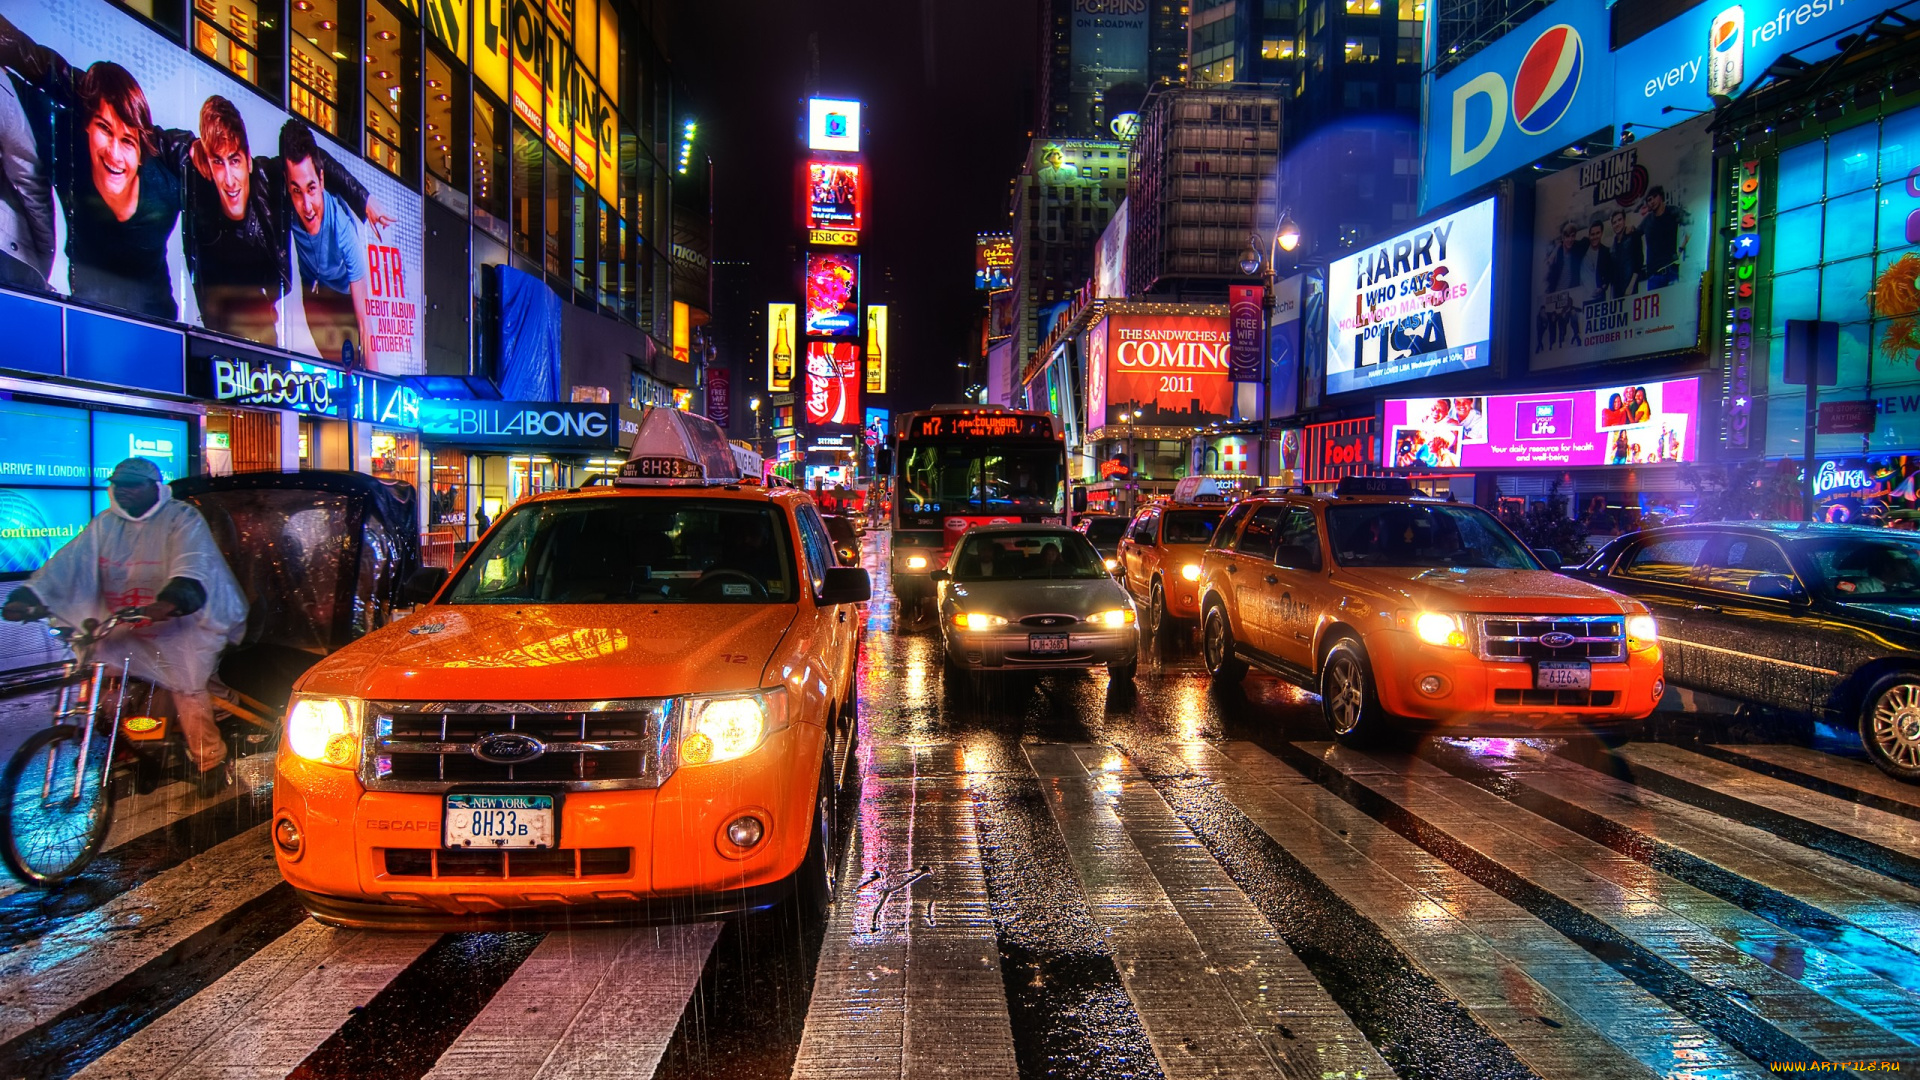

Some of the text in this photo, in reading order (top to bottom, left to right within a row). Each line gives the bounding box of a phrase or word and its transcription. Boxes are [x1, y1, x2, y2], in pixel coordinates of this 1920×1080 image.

[1077, 19, 1144, 29] ON BROADWAY
[1644, 56, 1703, 99] every
[558, 26, 612, 158] KING
[515, 94, 542, 130] ENTRANCE
[547, 127, 557, 144] ON
[1581, 148, 1637, 188] BIG TIME
[1599, 170, 1634, 201] RUSH
[1740, 159, 1758, 229] TOYS
[810, 231, 840, 243] HSBC
[1356, 220, 1454, 290] HARRY
[367, 243, 406, 299] BTR
[1365, 271, 1434, 308] WHO SAYS
[1738, 264, 1753, 298] US
[364, 298, 416, 320] DEBUT ALBUM
[1339, 283, 1467, 332] HOLLYWOOD MARRIAGES
[1584, 293, 1660, 335] ALBUM BTR
[1585, 299, 1625, 320] DEBUT
[378, 318, 414, 337] AVAILABLE
[1235, 318, 1258, 329] FREE
[1363, 318, 1394, 341] DON'T
[370, 335, 412, 353] OCTOBER 11
[1118, 329, 1142, 340] THE
[1144, 329, 1217, 341] SANDWICHES
[1236, 330, 1255, 340] WIFI
[1354, 311, 1448, 369] LISA
[1584, 332, 1621, 347] OCTOBER
[1623, 328, 1633, 339] 11
[1159, 376, 1194, 393] 2011
[1824, 404, 1871, 413] NO STOPPING
[460, 408, 609, 438] BILLABONG
[922, 416, 942, 436] M7
[974, 417, 1016, 427] COLUMBUS
[1831, 414, 1862, 422] ANYTIME
[1531, 421, 1556, 435] Life
[1324, 438, 1362, 466] Foot
[1491, 445, 1507, 453] Your
[1508, 444, 1527, 455] daily
[1561, 443, 1571, 452] for
[1572, 442, 1594, 452] health
[1515, 452, 1569, 463] and well-being
[35, 463, 46, 476] IN
[48, 464, 86, 479] LONDON
[642, 460, 680, 475] 8H33
[1366, 480, 1387, 491] 6J26
[720, 653, 749, 665] 12
[1549, 670, 1579, 684] 6J26A
[489, 740, 524, 755] Ford
[473, 798, 528, 809] NEW YORK
[366, 819, 440, 832] ESCAPE
